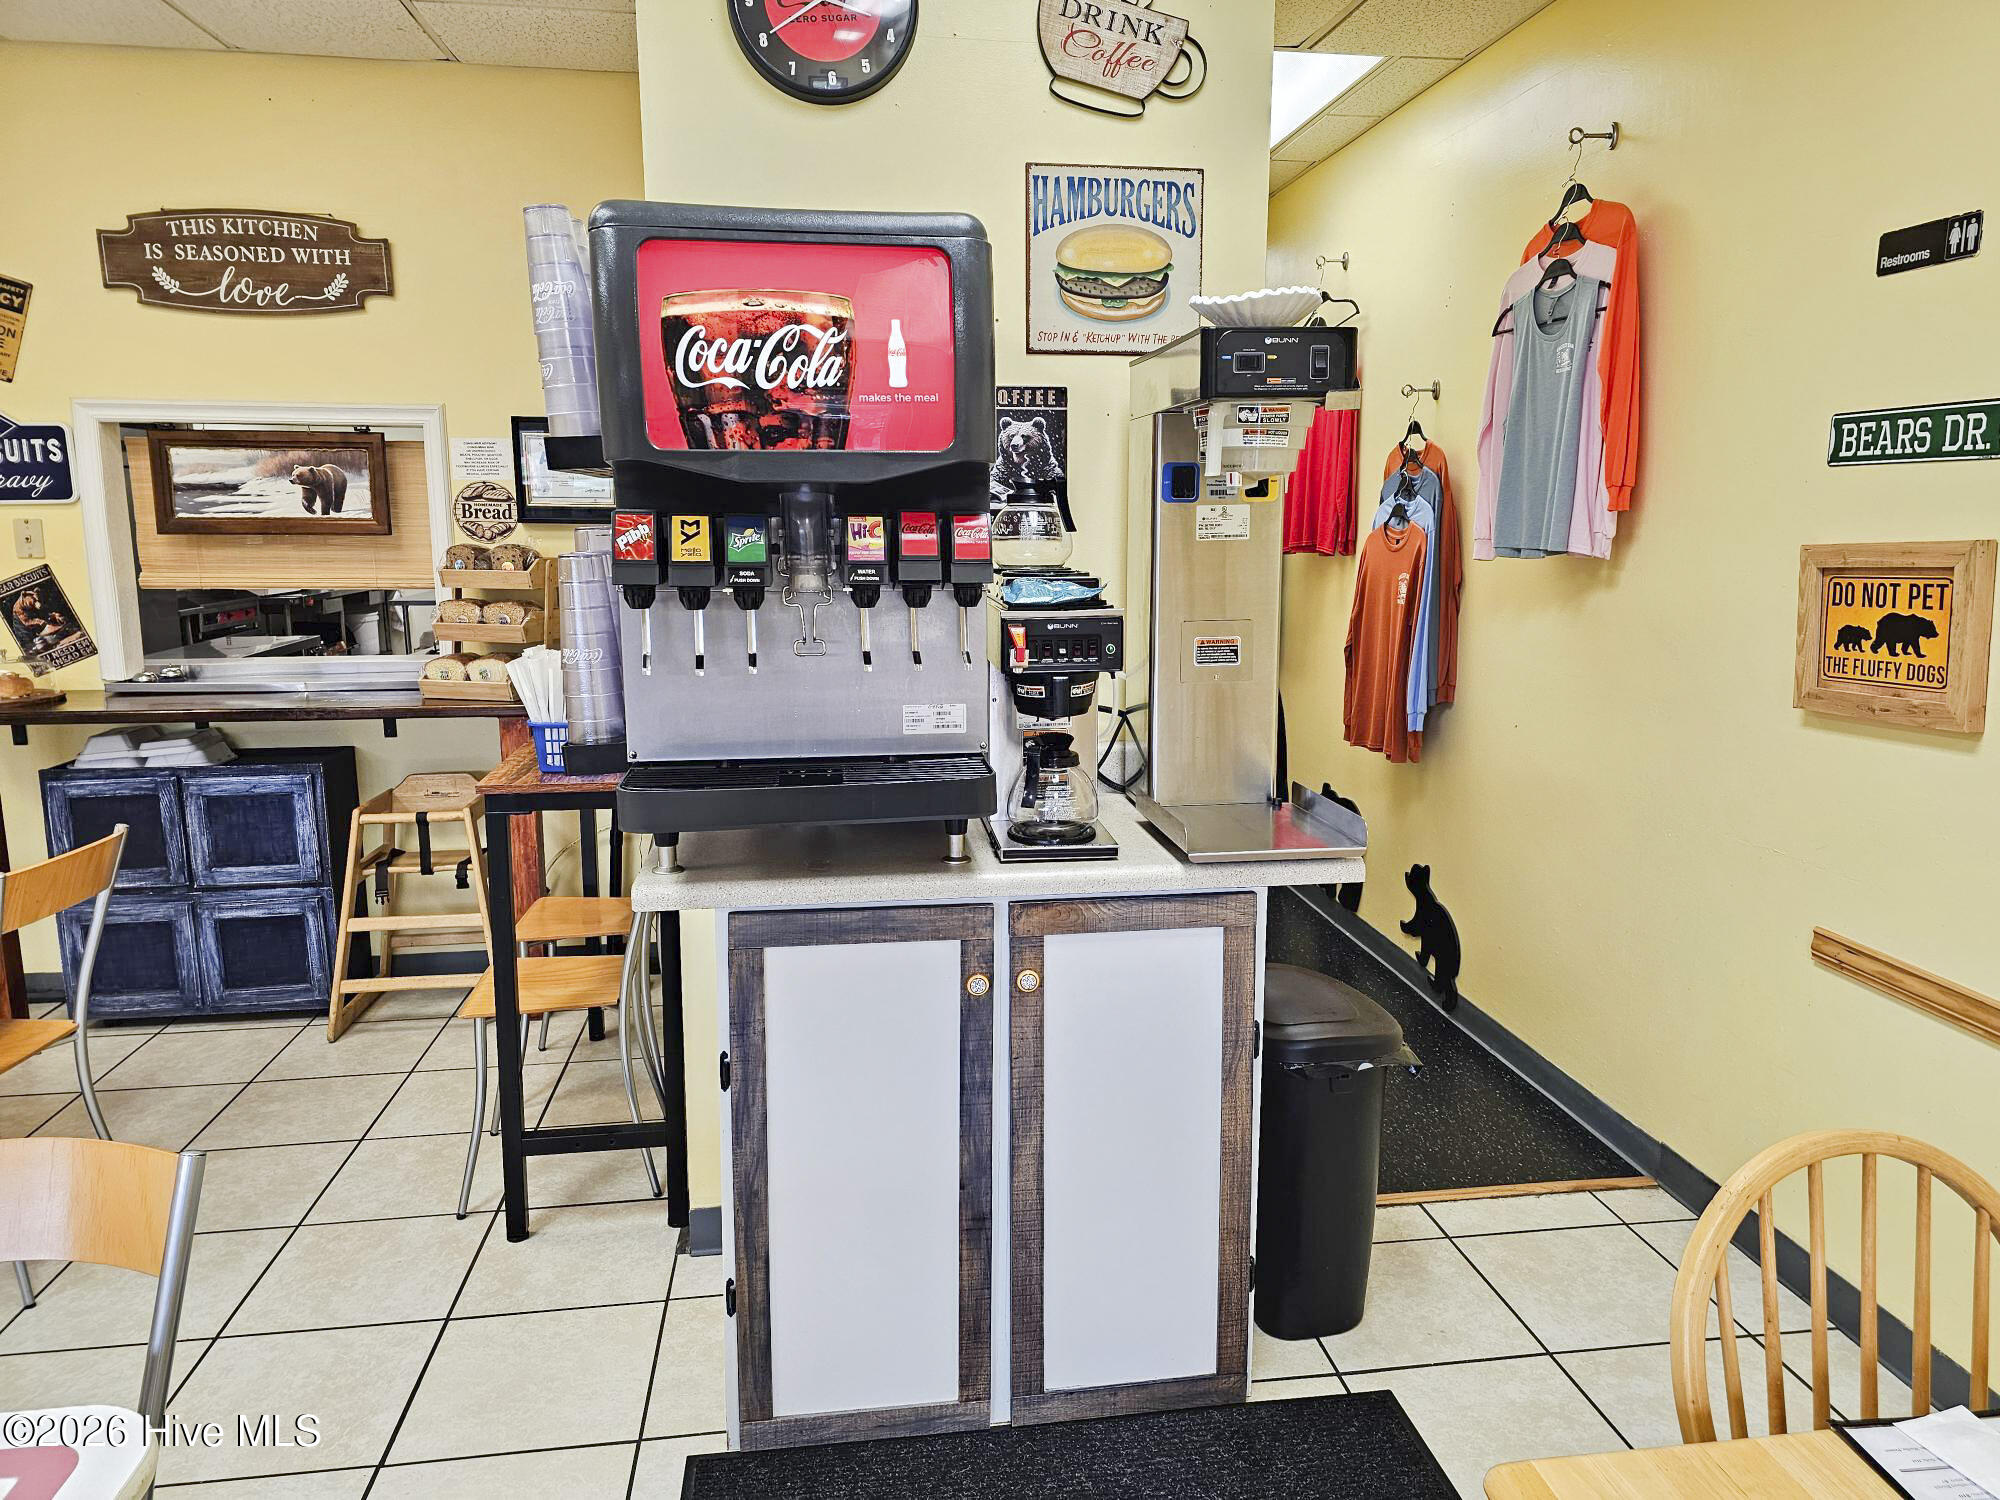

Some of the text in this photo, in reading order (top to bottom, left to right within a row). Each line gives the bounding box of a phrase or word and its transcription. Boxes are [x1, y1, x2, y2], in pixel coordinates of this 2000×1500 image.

[821, 14, 857, 22] SUGAR
[1058, 0, 1164, 46] DRINK
[759, 33, 768, 47] 8
[886, 28, 895, 43] 4
[1061, 22, 1158, 78] Coffee
[788, 61, 796, 75] 7
[861, 59, 871, 73] 5
[828, 71, 837, 85] 6
[1032, 174, 1197, 239] HAMBURGERS
[166, 218, 319, 242] THIS KITCHEN
[143, 242, 352, 266] IS SEASONED WITH
[1880, 249, 1931, 269] Restrooms
[219, 265, 295, 306] love
[1037, 331, 1057, 343] STOP
[1060, 331, 1071, 342] IN
[1128, 333, 1151, 344] WITH
[1152, 332, 1168, 345] THE
[675, 324, 848, 390] Coca-Cola
[859, 392, 939, 403] makes the meal
[1838, 412, 1991, 458] BEARS DR.
[461, 503, 513, 520] Bread
[850, 520, 882, 541] Hi-C
[902, 523, 935, 534] Coca-Cola
[734, 531, 762, 548] Sprite
[14, 568, 49, 587] BISCUITS
[1831, 581, 1950, 611] DO NOT PET
[1825, 656, 1946, 685] THE FLUFFY DOGS
